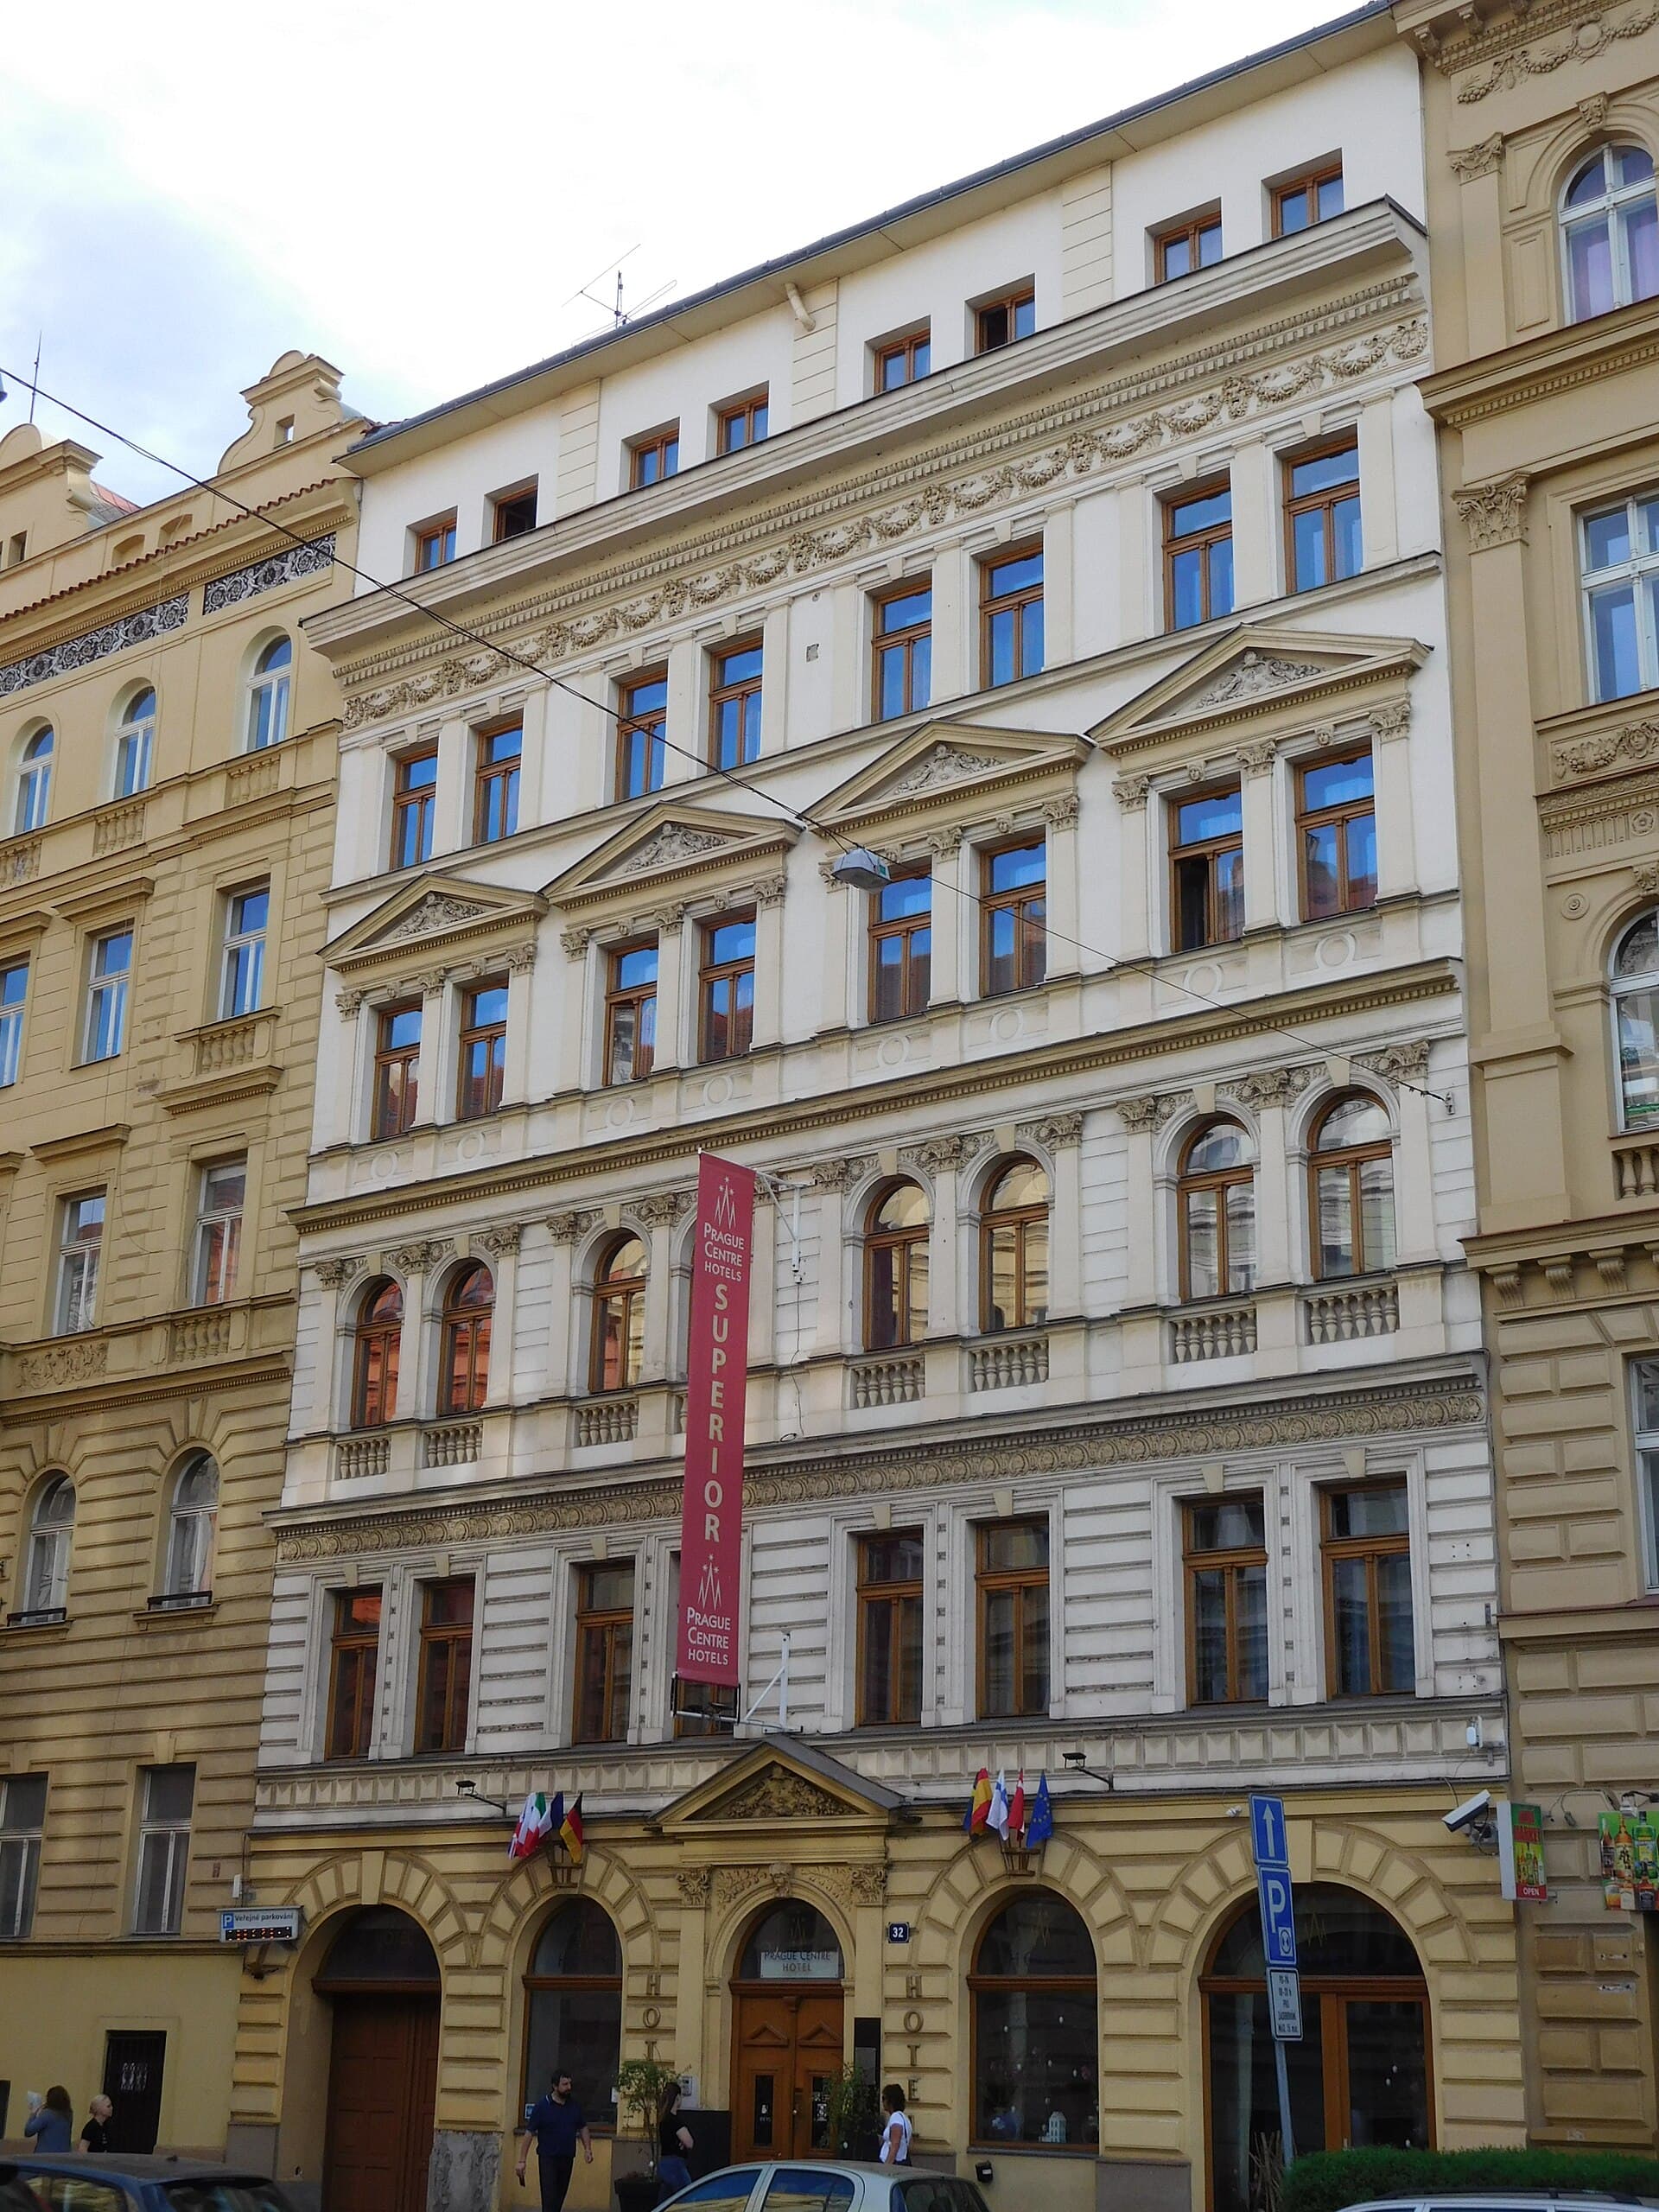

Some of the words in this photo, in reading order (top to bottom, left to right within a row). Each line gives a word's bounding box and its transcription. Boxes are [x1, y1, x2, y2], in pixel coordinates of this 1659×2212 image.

[703, 1222, 745, 1250] PRAGUE
[704, 1241, 743, 1268] CENTRE
[704, 1262, 742, 1282] HOTELS
[704, 1284, 729, 1542] SUPERIOR
[686, 1607, 731, 1631] PRAGUE
[687, 1627, 729, 1649] CENTRE
[688, 1648, 728, 1666] HOTELS
[1522, 1886, 1540, 1896] OPEN
[1267, 1879, 1286, 1934] P
[892, 1926, 905, 1938] 32
[782, 1962, 812, 1972] HOTEL
